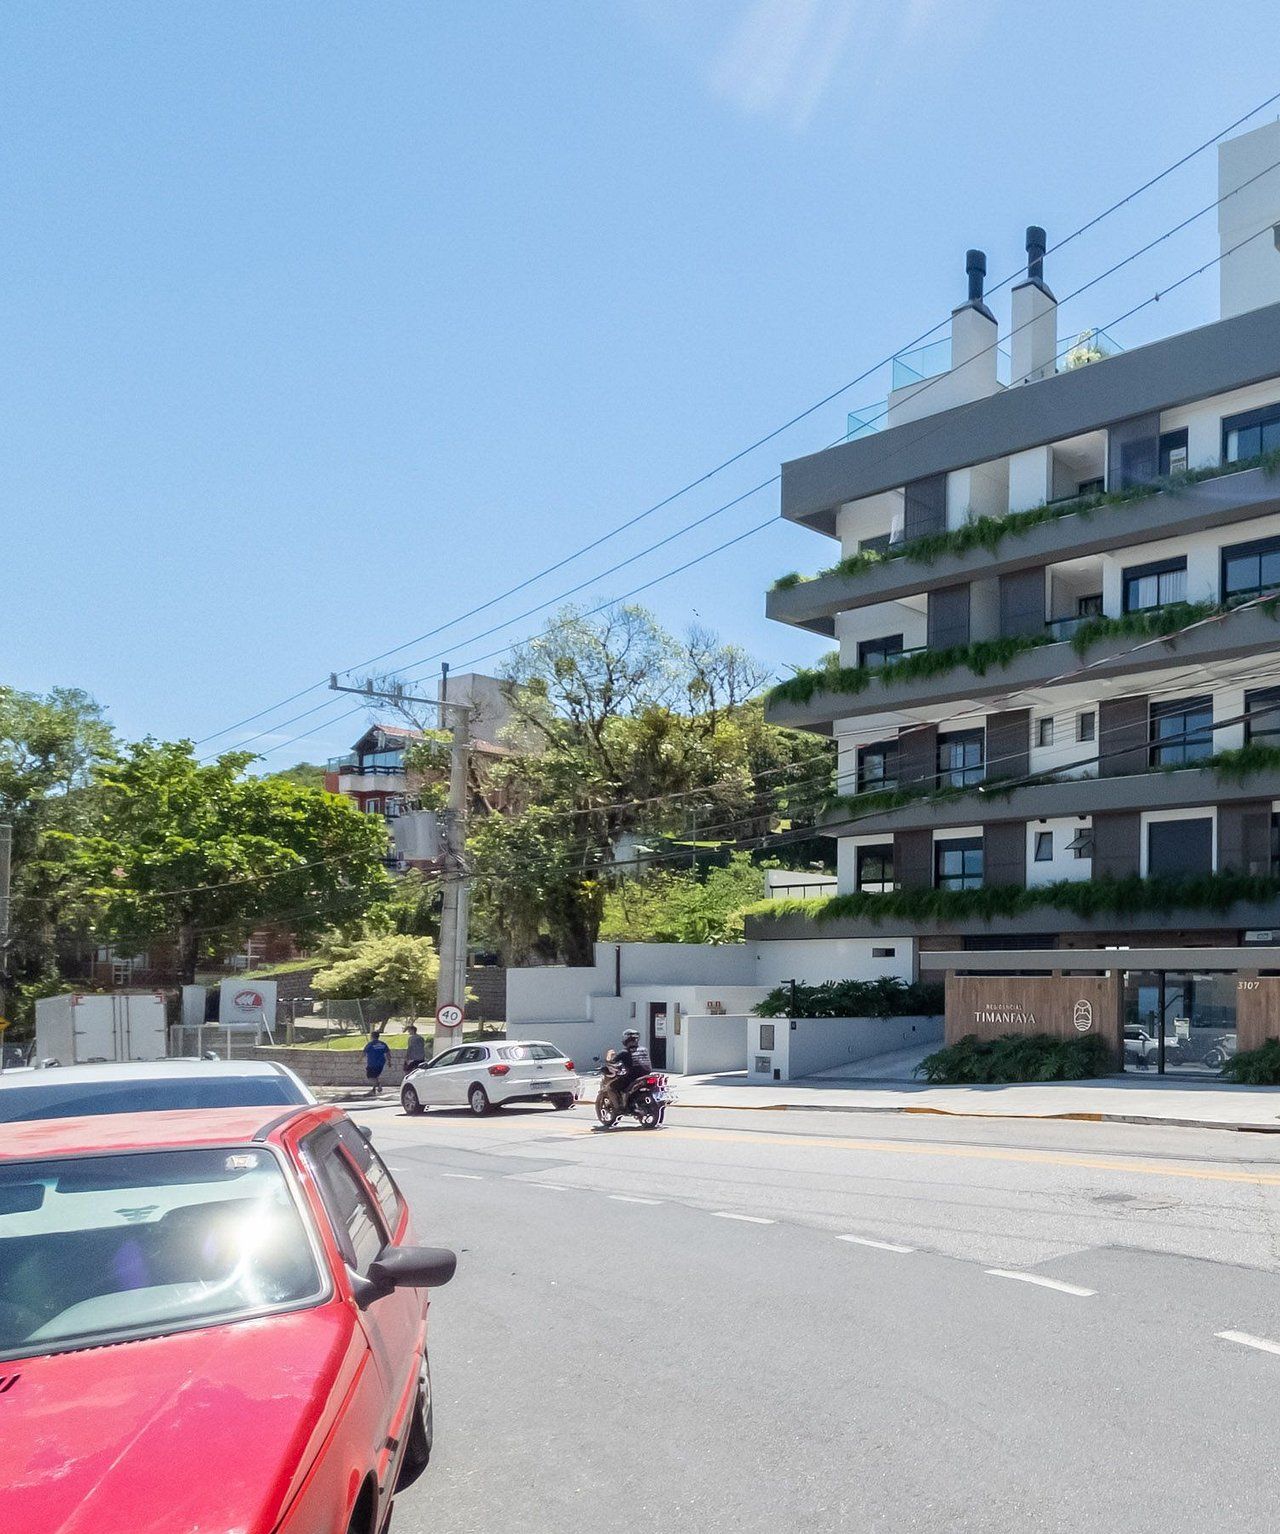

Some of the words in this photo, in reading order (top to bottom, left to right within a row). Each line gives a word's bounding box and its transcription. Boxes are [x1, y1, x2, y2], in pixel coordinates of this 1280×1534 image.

[1237, 981, 1260, 990] 3107
[442, 1010, 458, 1020] 40
[974, 1012, 1036, 1024] TIMANFAYA
